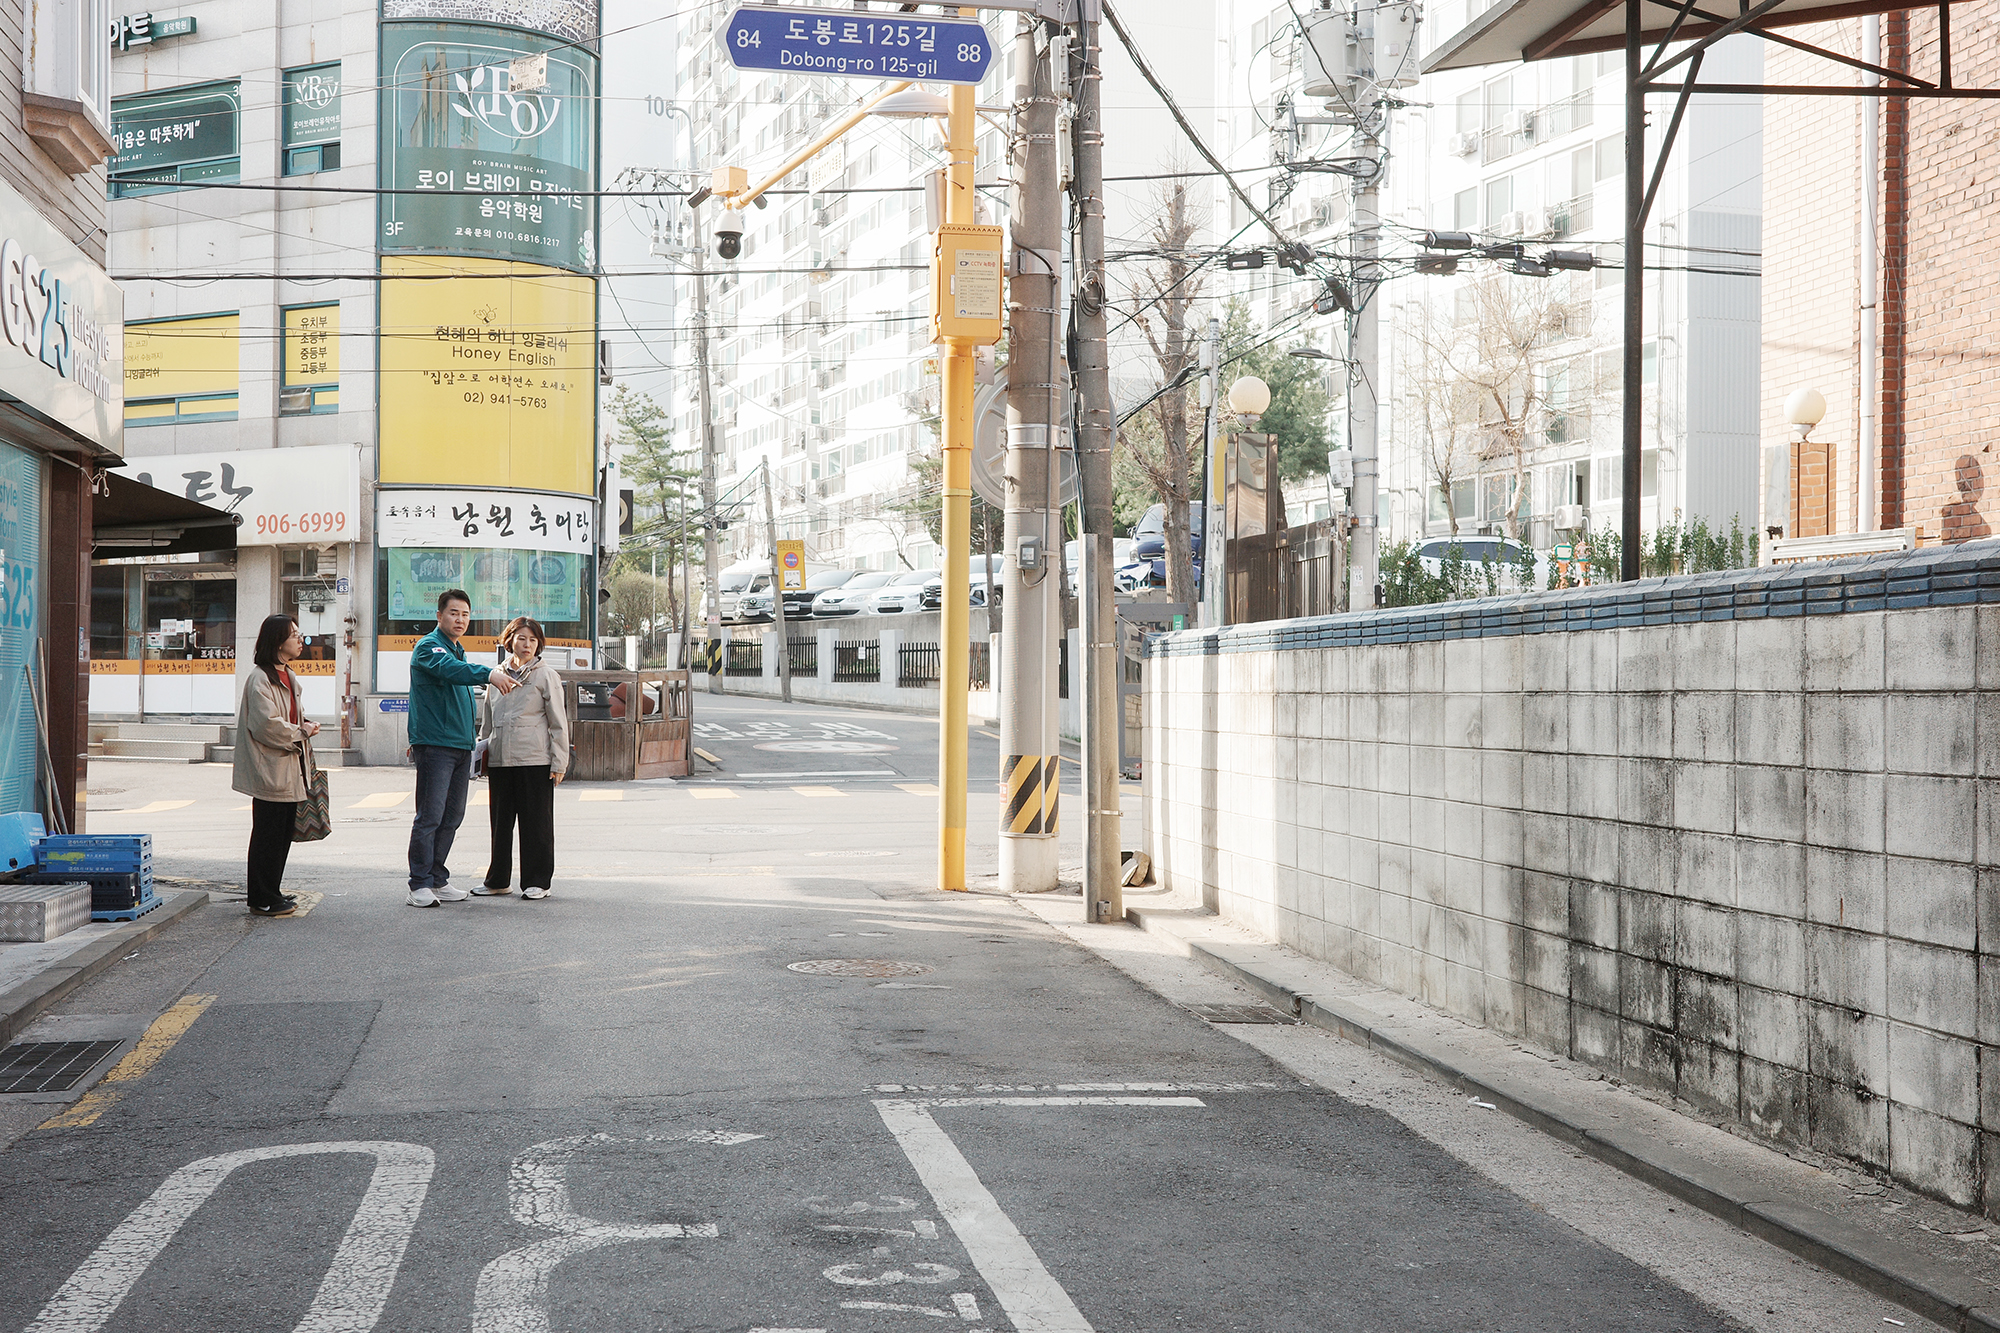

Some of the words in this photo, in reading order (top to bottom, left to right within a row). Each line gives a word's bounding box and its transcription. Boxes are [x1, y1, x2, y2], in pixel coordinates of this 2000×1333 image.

[737, 29, 761, 48] 84
[785, 19, 936, 52] 도봉로125길
[781, 50, 874, 72] Dobong-ro
[881, 56, 938, 76] 125-gil
[957, 44, 981, 62] 88
[112, 129, 146, 149] 마음은
[490, 161, 511, 169] BRAIN
[416, 169, 454, 191] 로이
[463, 171, 520, 197] 브레인
[528, 179, 584, 211] 뮤직아트
[479, 198, 543, 223] 음악학원
[385, 221, 404, 236] 3F
[454, 227, 492, 239] 교육문의
[496, 231, 560, 247] 010.6816.1217
[1, 238, 72, 378] GS25
[300, 316, 327, 329] 유치부
[73, 304, 110, 364] Lifestyle
[300, 331, 327, 344] 초등부
[435, 326, 480, 342] 현혜의
[488, 329, 514, 345] 허니
[522, 333, 568, 353] 잉글리쉬
[300, 347, 327, 360] 중등부
[452, 346, 501, 362] Honey
[508, 349, 556, 366] English
[73, 349, 111, 404] Platform
[125, 367, 160, 380] 니잉글리쉬
[300, 362, 327, 374] 고등부
[488, 375, 534, 388] 어학연수
[464, 392, 485, 405] 02)
[490, 394, 547, 408] 941-5763
[256, 511, 346, 534] 906-6999
[451, 503, 514, 538] 남원
